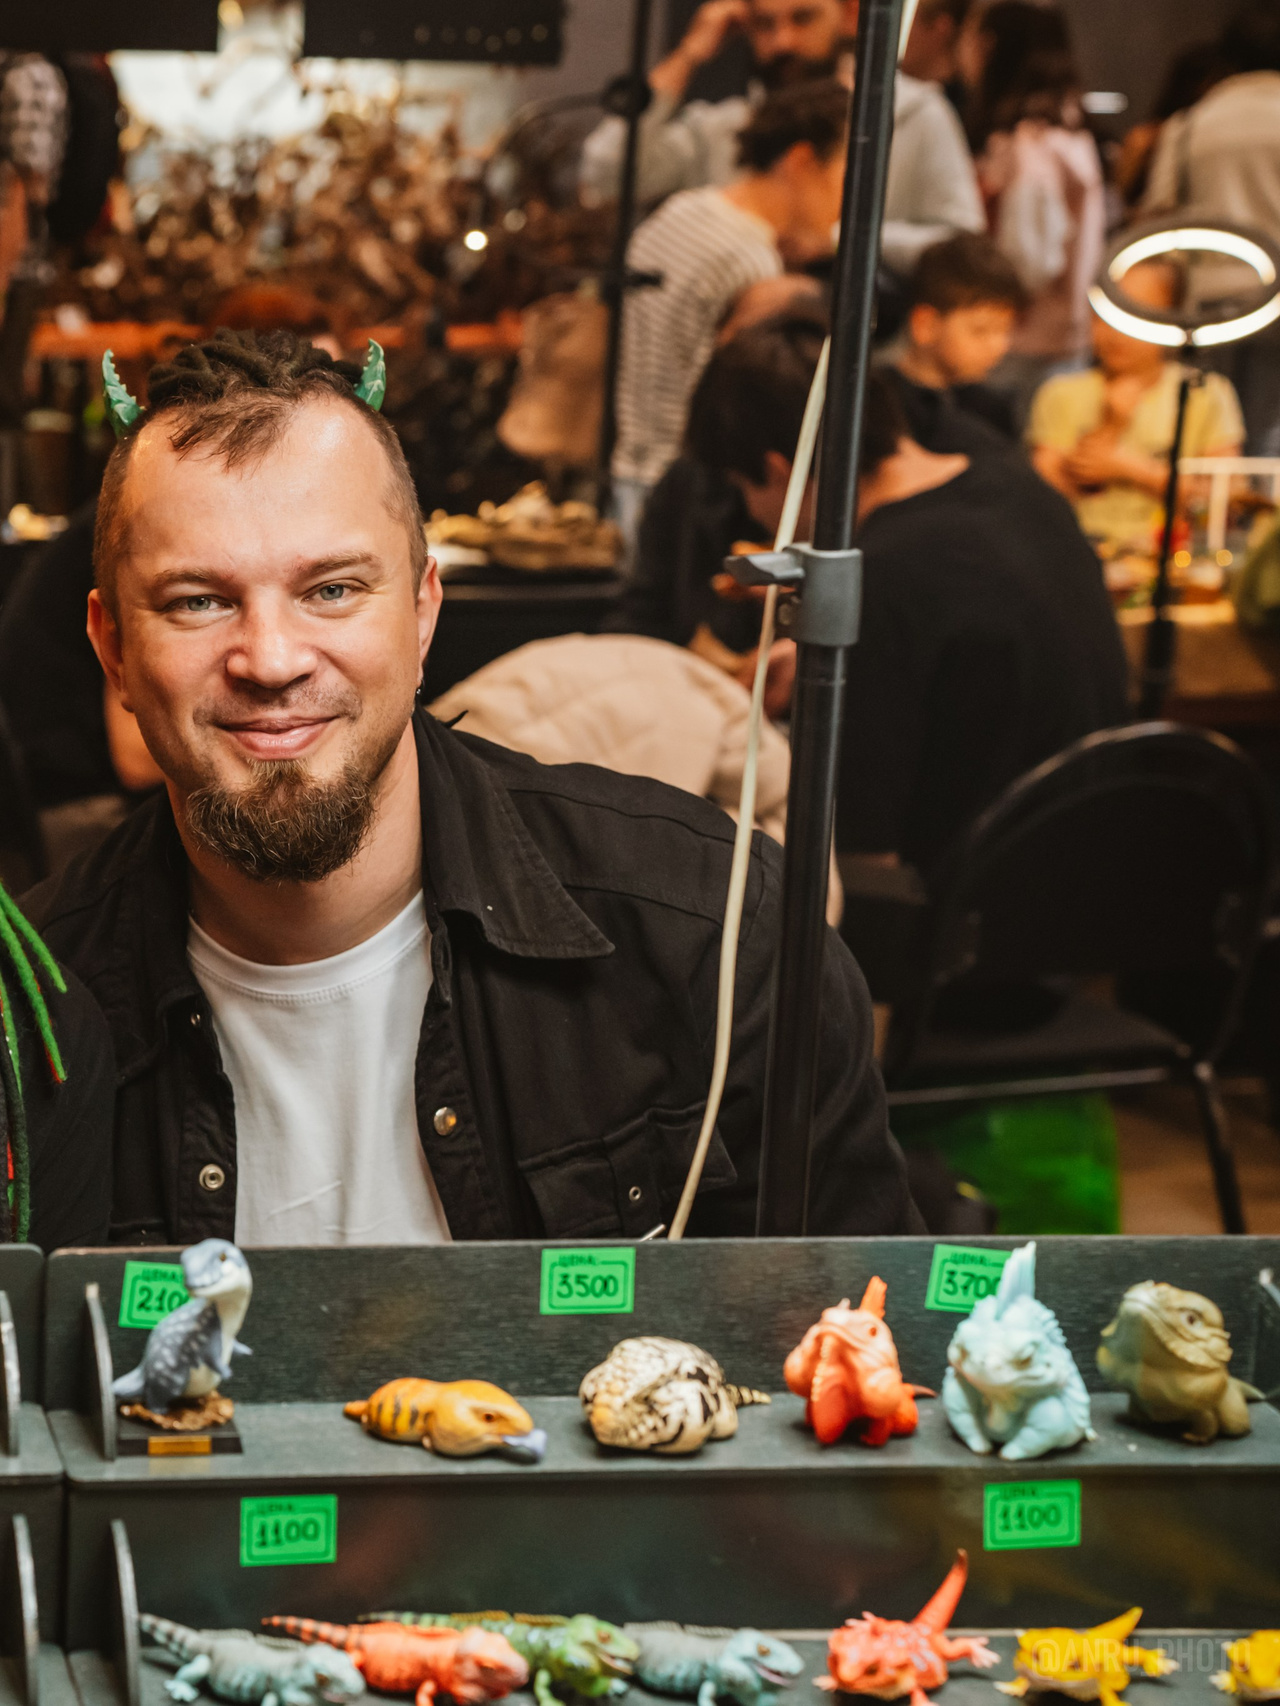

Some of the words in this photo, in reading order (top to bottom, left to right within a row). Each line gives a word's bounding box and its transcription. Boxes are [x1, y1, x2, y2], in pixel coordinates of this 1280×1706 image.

[136, 1286, 190, 1312] 210
[557, 1273, 619, 1299] 3500
[1000, 1504, 1062, 1532] 1100
[255, 1519, 321, 1549] 1100
